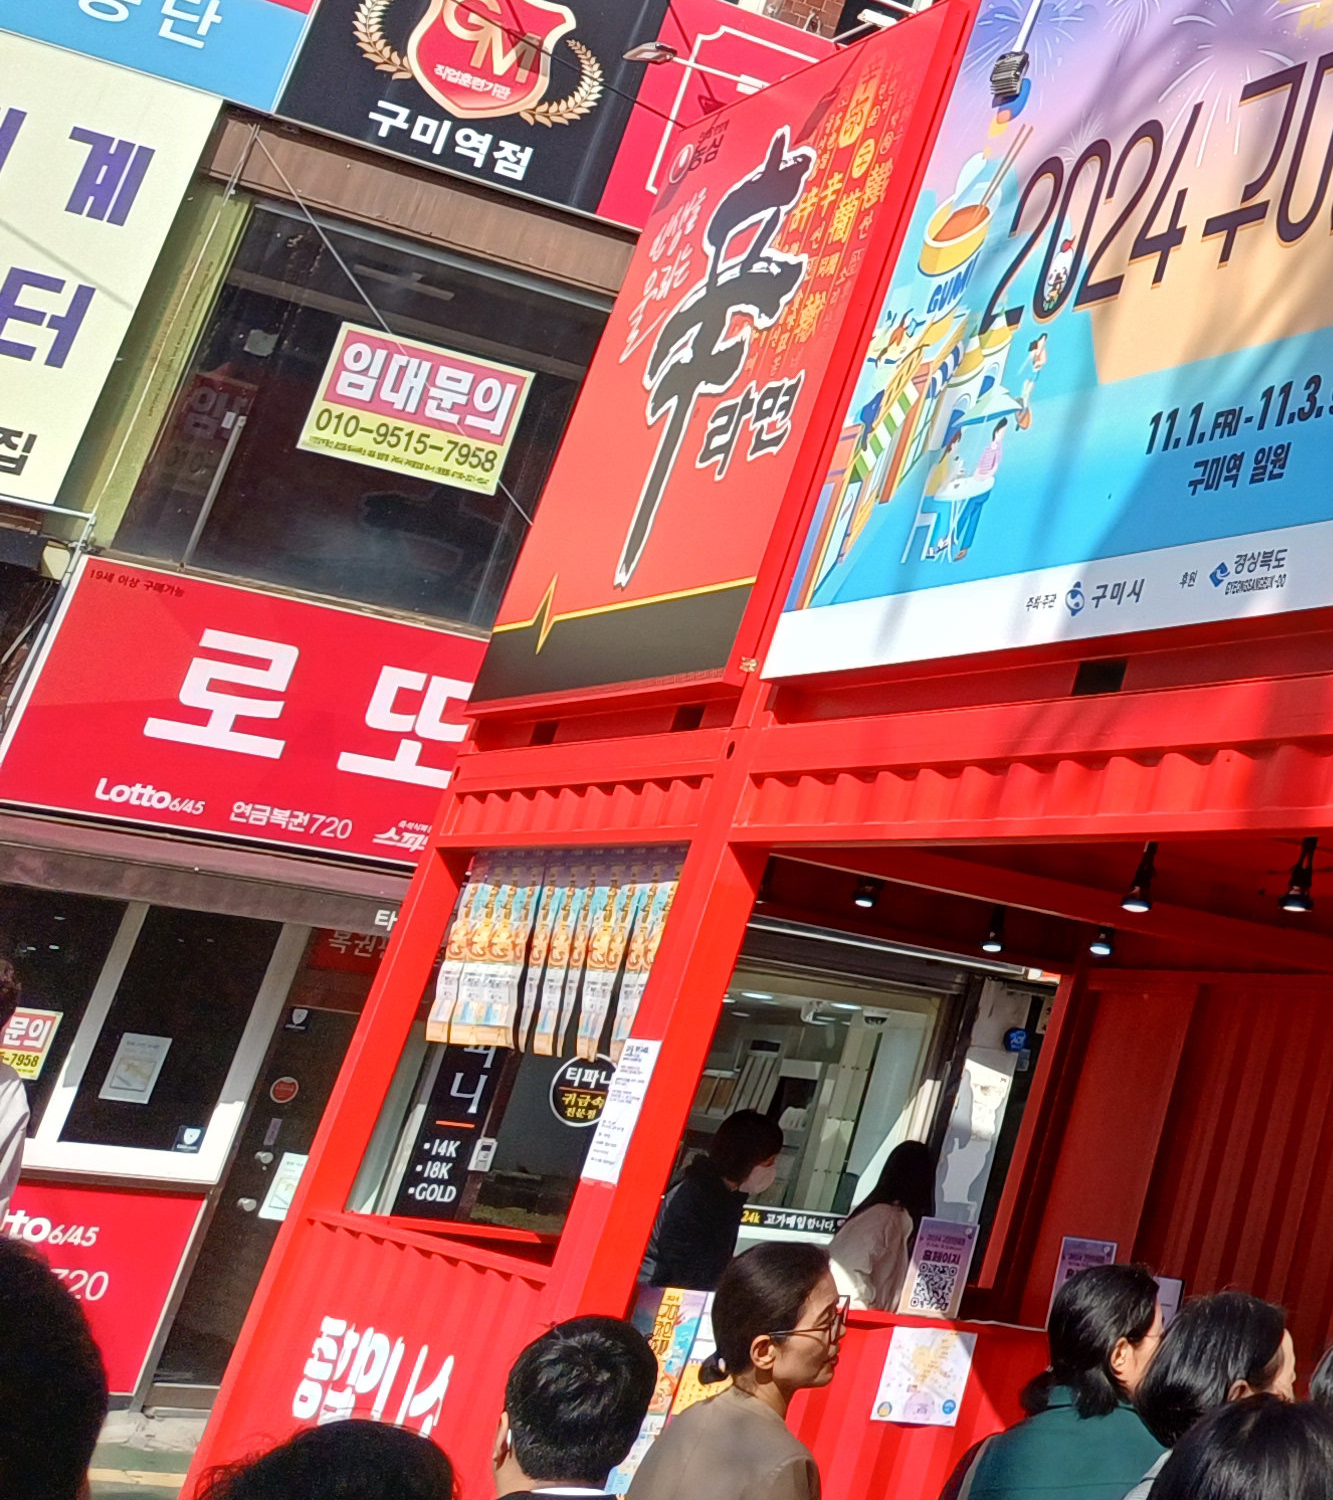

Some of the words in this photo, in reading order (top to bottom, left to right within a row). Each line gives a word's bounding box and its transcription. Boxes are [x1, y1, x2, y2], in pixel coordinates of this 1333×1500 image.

[433, 63, 512, 101] 직업훈련기관
[369, 100, 534, 180] 구미역점
[982, 102, 1205, 336] 2024
[928, 252, 980, 314] GUMI
[614, 125, 816, 590] 辛
[336, 342, 518, 437] 임대문의
[315, 408, 498, 473] 010-9515-7958
[696, 370, 805, 482] 라면
[1209, 406, 1243, 442] FRI
[1188, 452, 1245, 496] 구미역
[1249, 442, 1292, 485] 일원
[90, 568, 114, 583] 19세
[118, 574, 140, 588] 이상
[1179, 570, 1198, 588] 후원
[1234, 549, 1288, 575] 경상북도
[1091, 578, 1145, 609] 구미시
[229, 800, 353, 840] 연금복권720
[3, 1015, 52, 1049] 문의
[431, 1139, 461, 1159] 14K
[424, 1162, 452, 1180] 18K
[415, 1183, 457, 1203] GOLD
